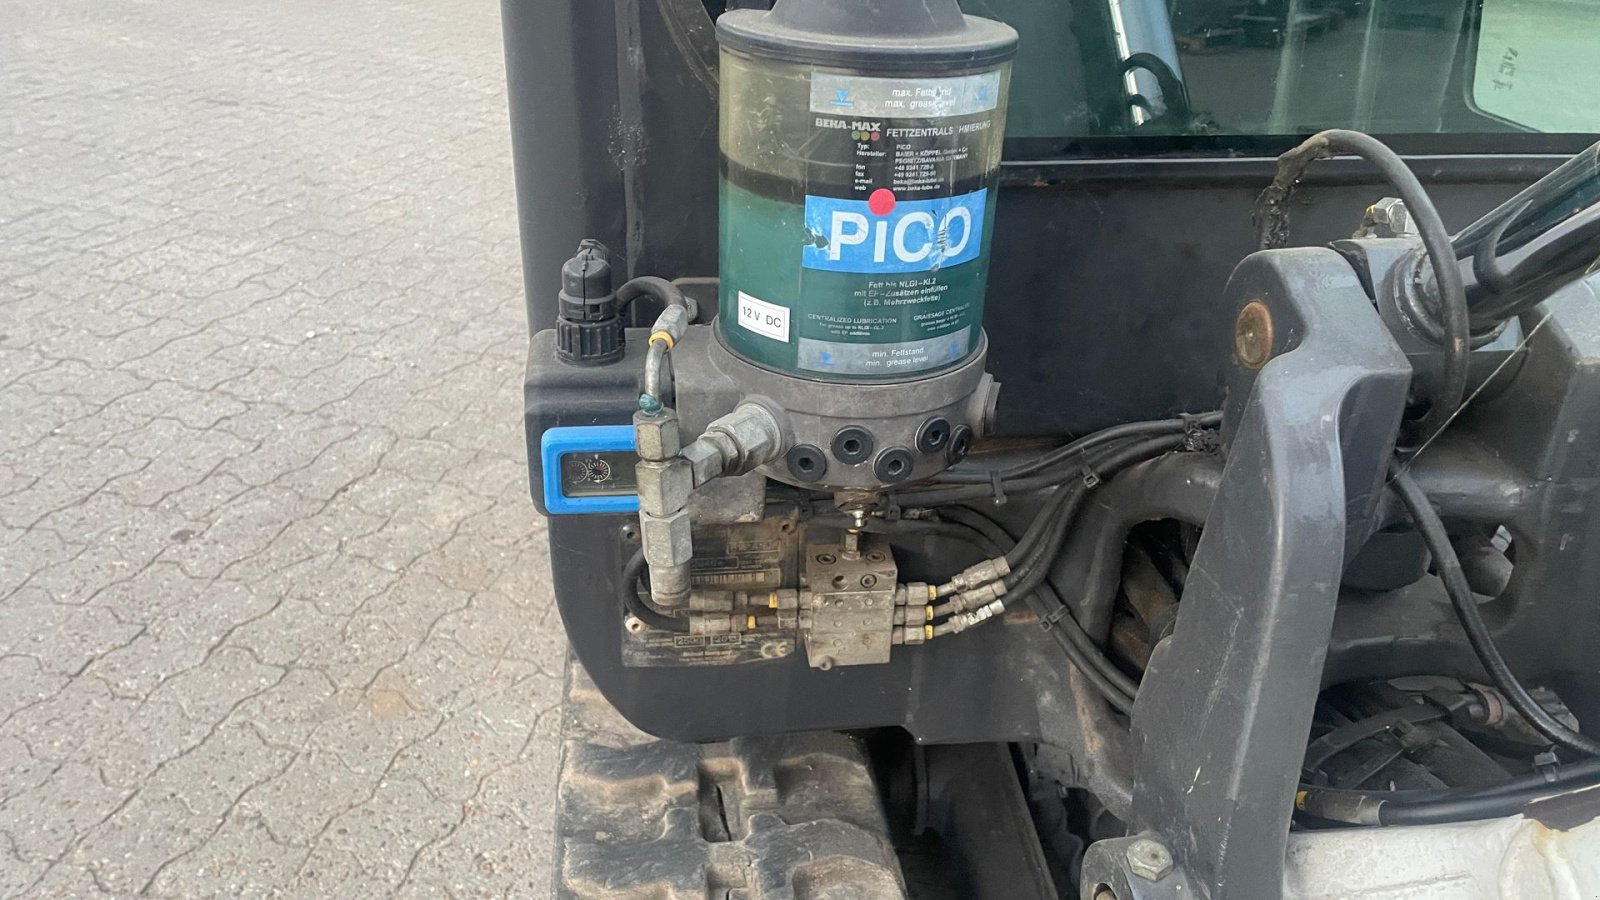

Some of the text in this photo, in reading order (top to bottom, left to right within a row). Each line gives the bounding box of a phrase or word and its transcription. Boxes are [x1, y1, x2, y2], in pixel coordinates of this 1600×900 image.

[892, 89, 912, 97] max.
[885, 100, 905, 108] max.
[815, 117, 881, 131] BEKA-MAX
[920, 285, 948, 294] einfüllen
[742, 305, 782, 328] 12 V DC
[807, 313, 852, 323] CENTRALIZED
[872, 347, 924, 358] min. Fettstand
[886, 358, 912, 368] grease
[912, 355, 929, 364] level
